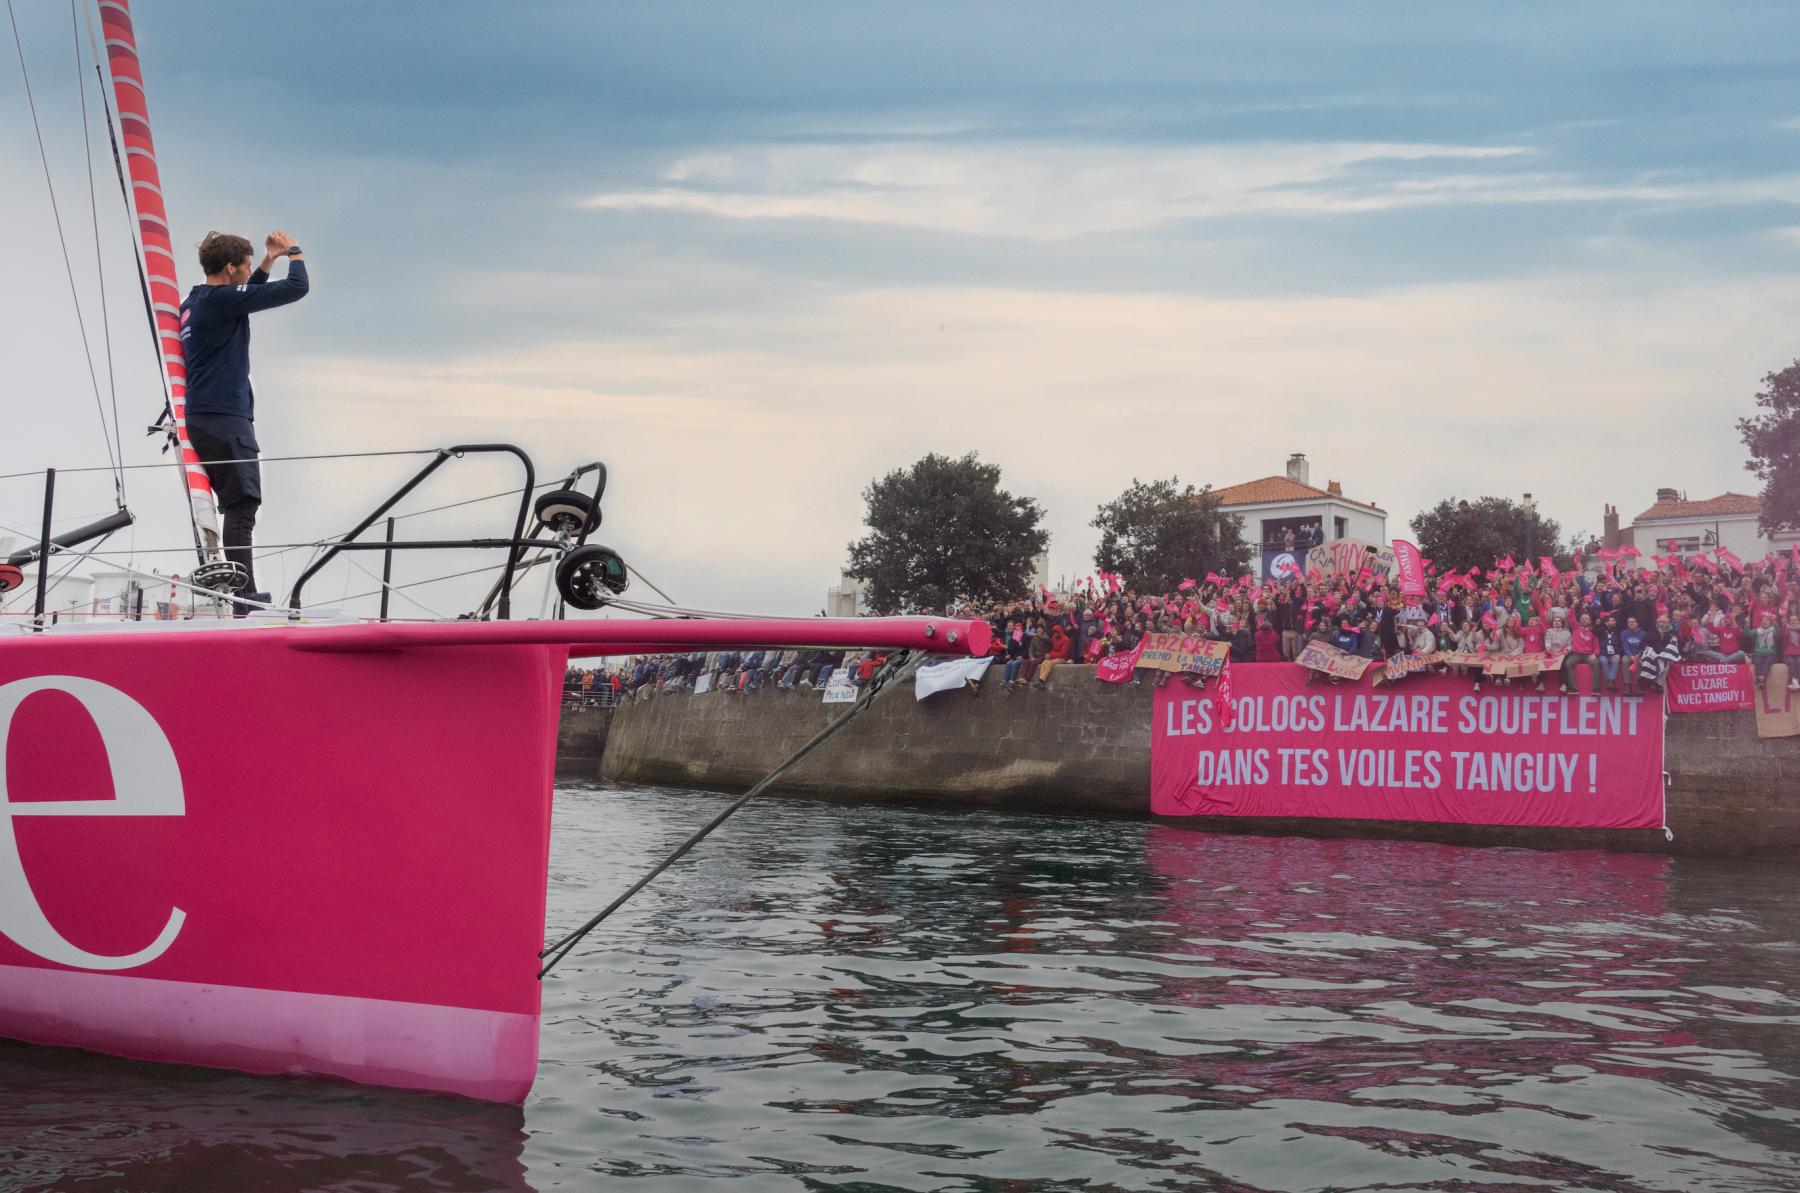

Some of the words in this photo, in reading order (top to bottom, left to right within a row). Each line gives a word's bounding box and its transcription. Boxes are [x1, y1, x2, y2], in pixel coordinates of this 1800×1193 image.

[1681, 665, 1699, 677] LES
[1700, 664, 1737, 676] COLOCS
[1691, 678, 1729, 690] LAZARE
[1677, 693, 1702, 705] AVEC
[1703, 690, 1740, 704] TANGUY
[1167, 699, 1213, 736] LES
[1334, 695, 1450, 733] LAZARE
[1458, 696, 1644, 735] SOUFFLENT
[1198, 748, 1269, 786] DANS
[1277, 748, 1329, 786] TES
[1338, 749, 1442, 789] VOILES
[1451, 751, 1579, 793] TANGUY
[1588, 753, 1597, 793] !
